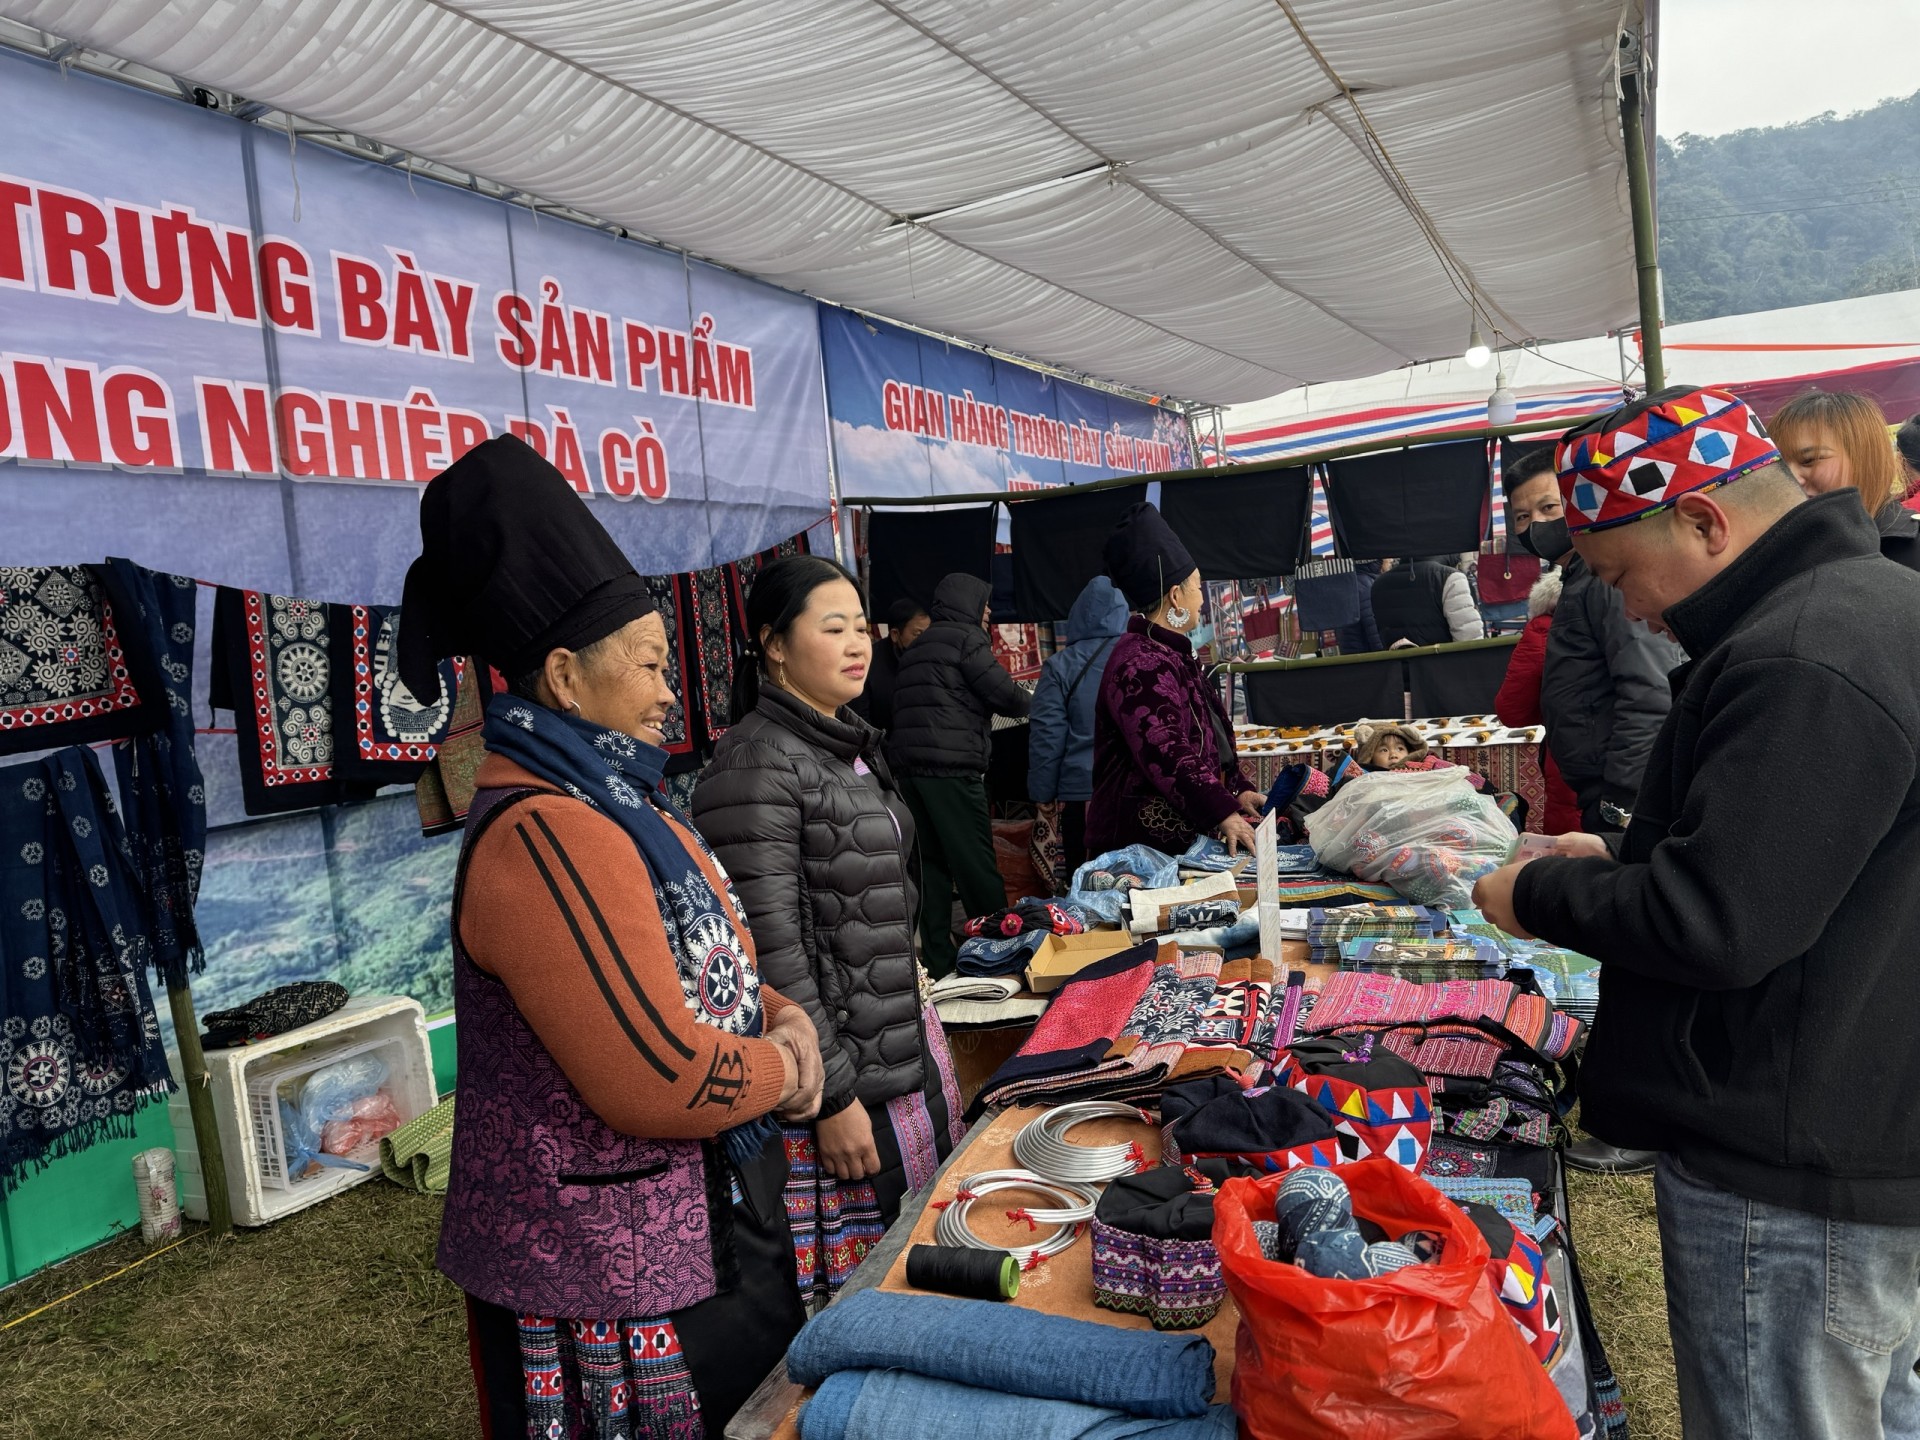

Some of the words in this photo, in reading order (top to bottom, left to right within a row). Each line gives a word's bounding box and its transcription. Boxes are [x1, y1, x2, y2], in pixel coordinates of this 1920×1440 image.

[0, 180, 315, 331] TRƯNG
[336, 254, 474, 357] BÀY
[498, 281, 613, 383] SẢN
[626, 316, 753, 407] PHẨM
[0, 360, 175, 467] NG
[602, 421, 667, 500] CÒ
[884, 382, 946, 438] GIAN
[950, 393, 1009, 450] HÀNG
[1010, 413, 1070, 460] TRƯNG
[1070, 420, 1101, 465] BÀY
[1105, 424, 1134, 470] SẢN
